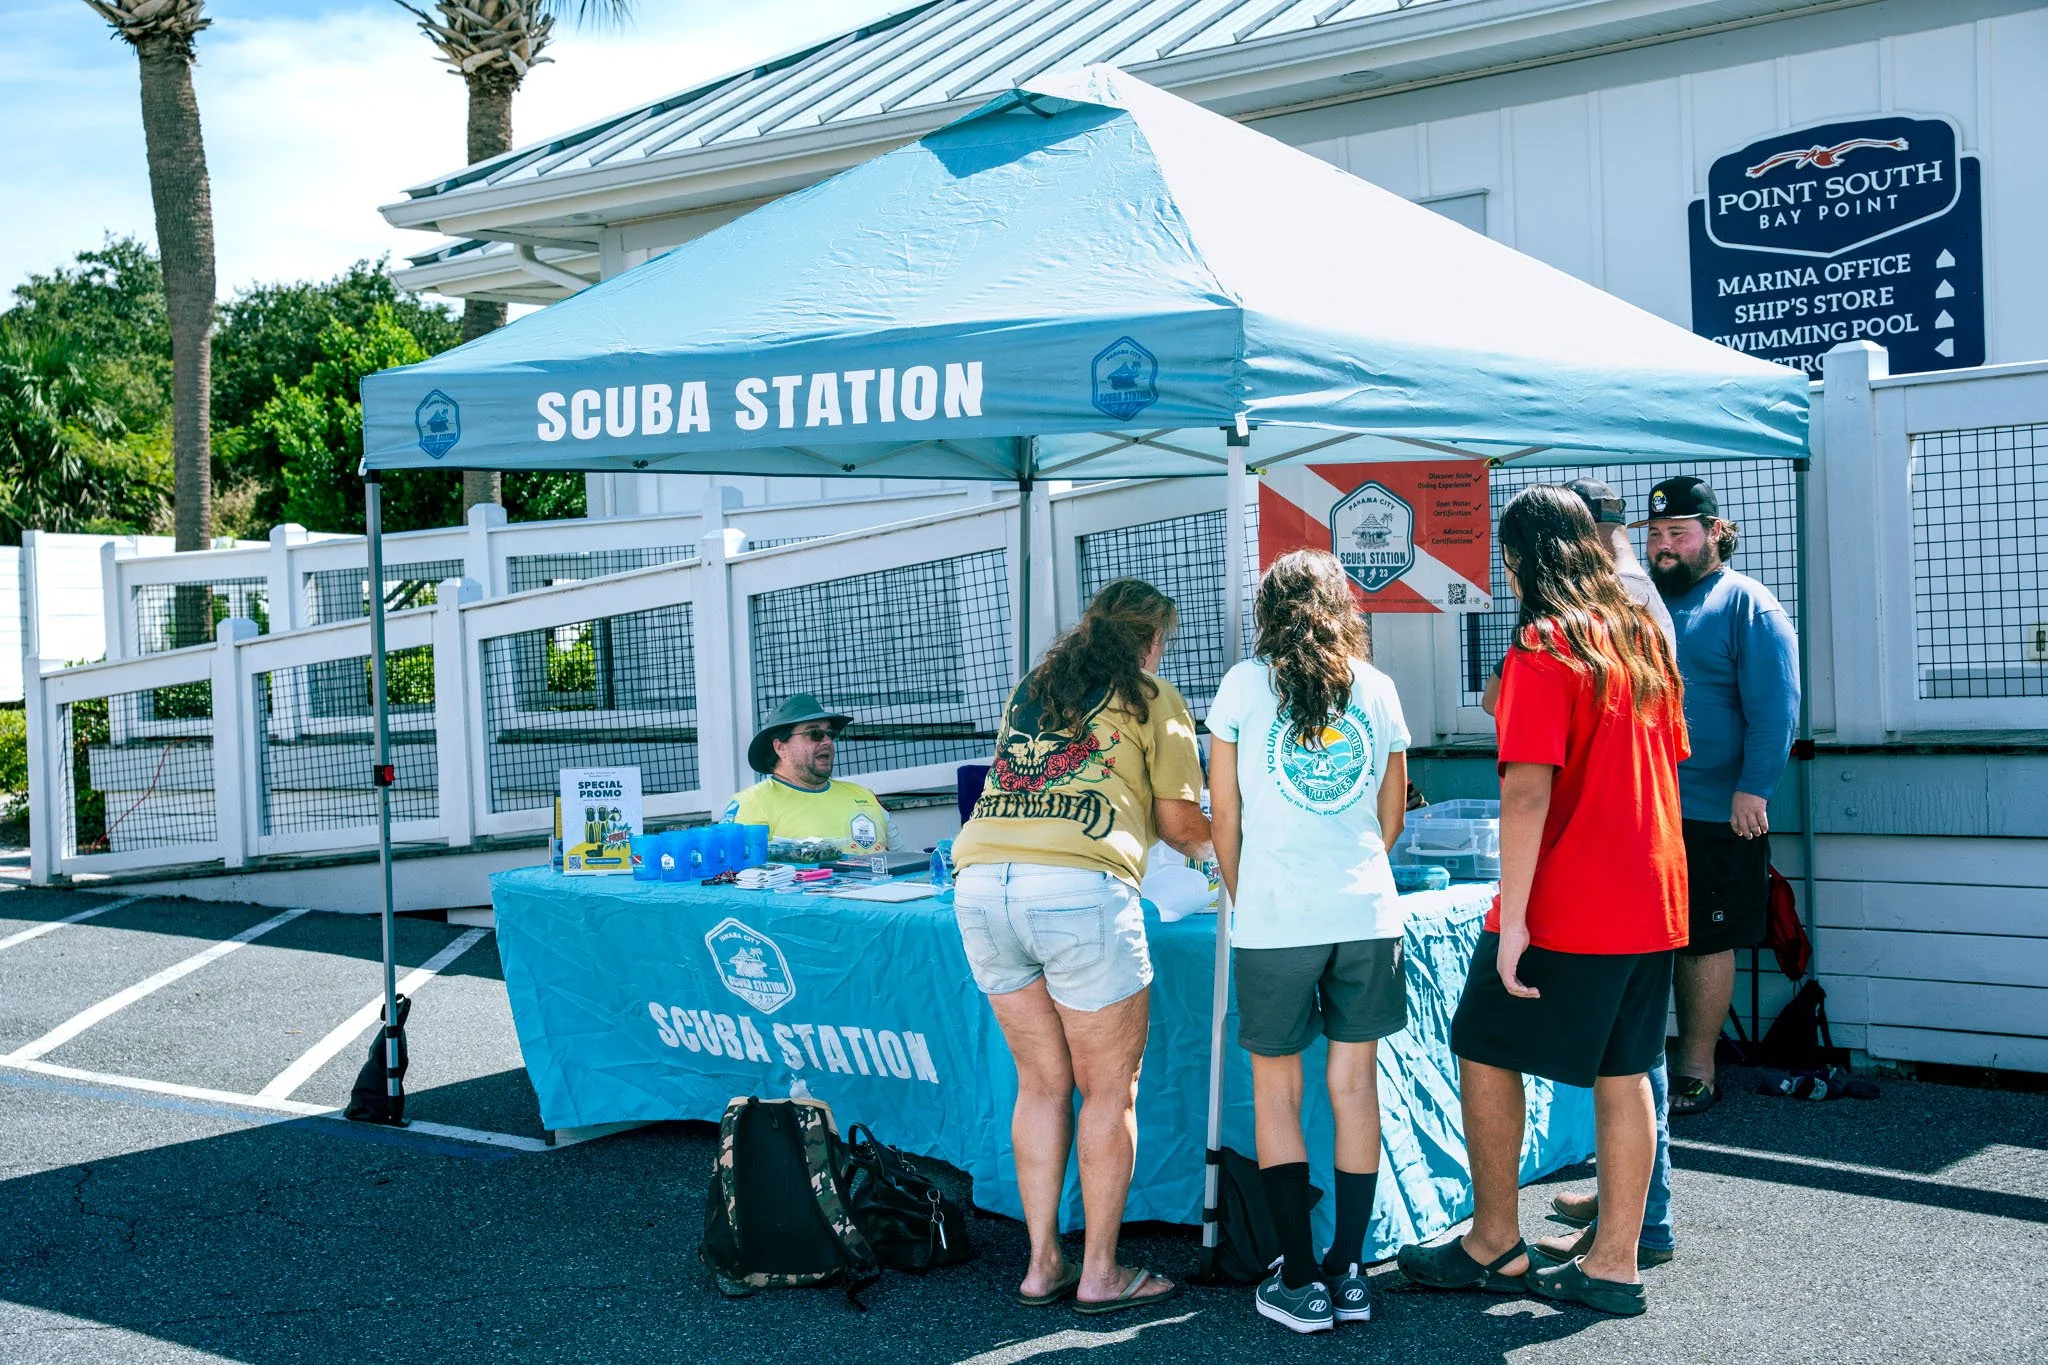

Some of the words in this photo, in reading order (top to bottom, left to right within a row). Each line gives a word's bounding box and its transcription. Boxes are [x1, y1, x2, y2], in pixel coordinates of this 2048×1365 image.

[1718, 180, 1817, 216] POINT
[1825, 160, 1943, 199] SOUTH
[1759, 209, 1801, 229] BAY
[1819, 194, 1899, 220] POINT
[1717, 267, 1819, 297] MARINA
[1824, 253, 1911, 282] OFFICE
[1734, 297, 1808, 324] SHIP'S
[1814, 286, 1894, 315] STORE
[1851, 313, 1920, 339] POOL
[537, 381, 711, 442] SCUBA
[735, 361, 983, 431] STATION
[1438, 481, 1472, 490] Experiences
[1348, 497, 1378, 511] PANAMA
[1380, 498, 1396, 510] CITY
[1433, 509, 1472, 518] Certification
[1340, 552, 1366, 565] SCUBA
[1370, 551, 1406, 565] STATION
[1379, 568, 1388, 578] 23
[578, 780, 623, 790] SPECIAL
[579, 789, 622, 798] PROMO
[1308, 777, 1354, 800] TURTLES
[753, 979, 787, 994] STATION
[648, 1001, 773, 1064] SCUBA
[772, 1022, 940, 1084] STATION
